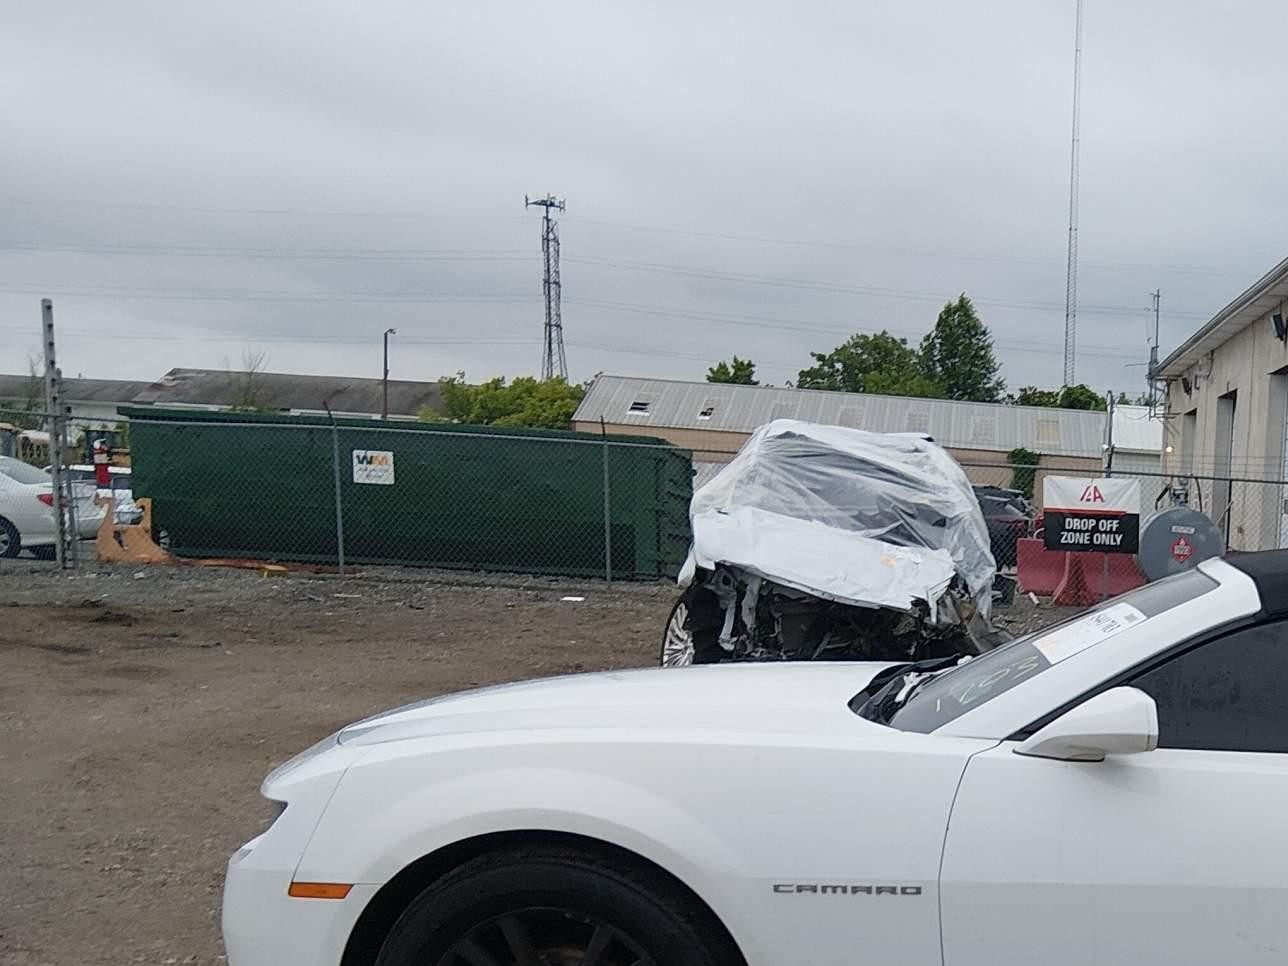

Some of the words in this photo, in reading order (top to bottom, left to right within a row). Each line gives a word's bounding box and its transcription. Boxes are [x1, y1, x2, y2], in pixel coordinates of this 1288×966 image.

[1065, 517, 1097, 531] DROP
[1098, 519, 1120, 532] OFF
[1060, 531, 1091, 544] ZONE
[1093, 533, 1123, 546] ONLY
[772, 884, 922, 896] CAMARO
